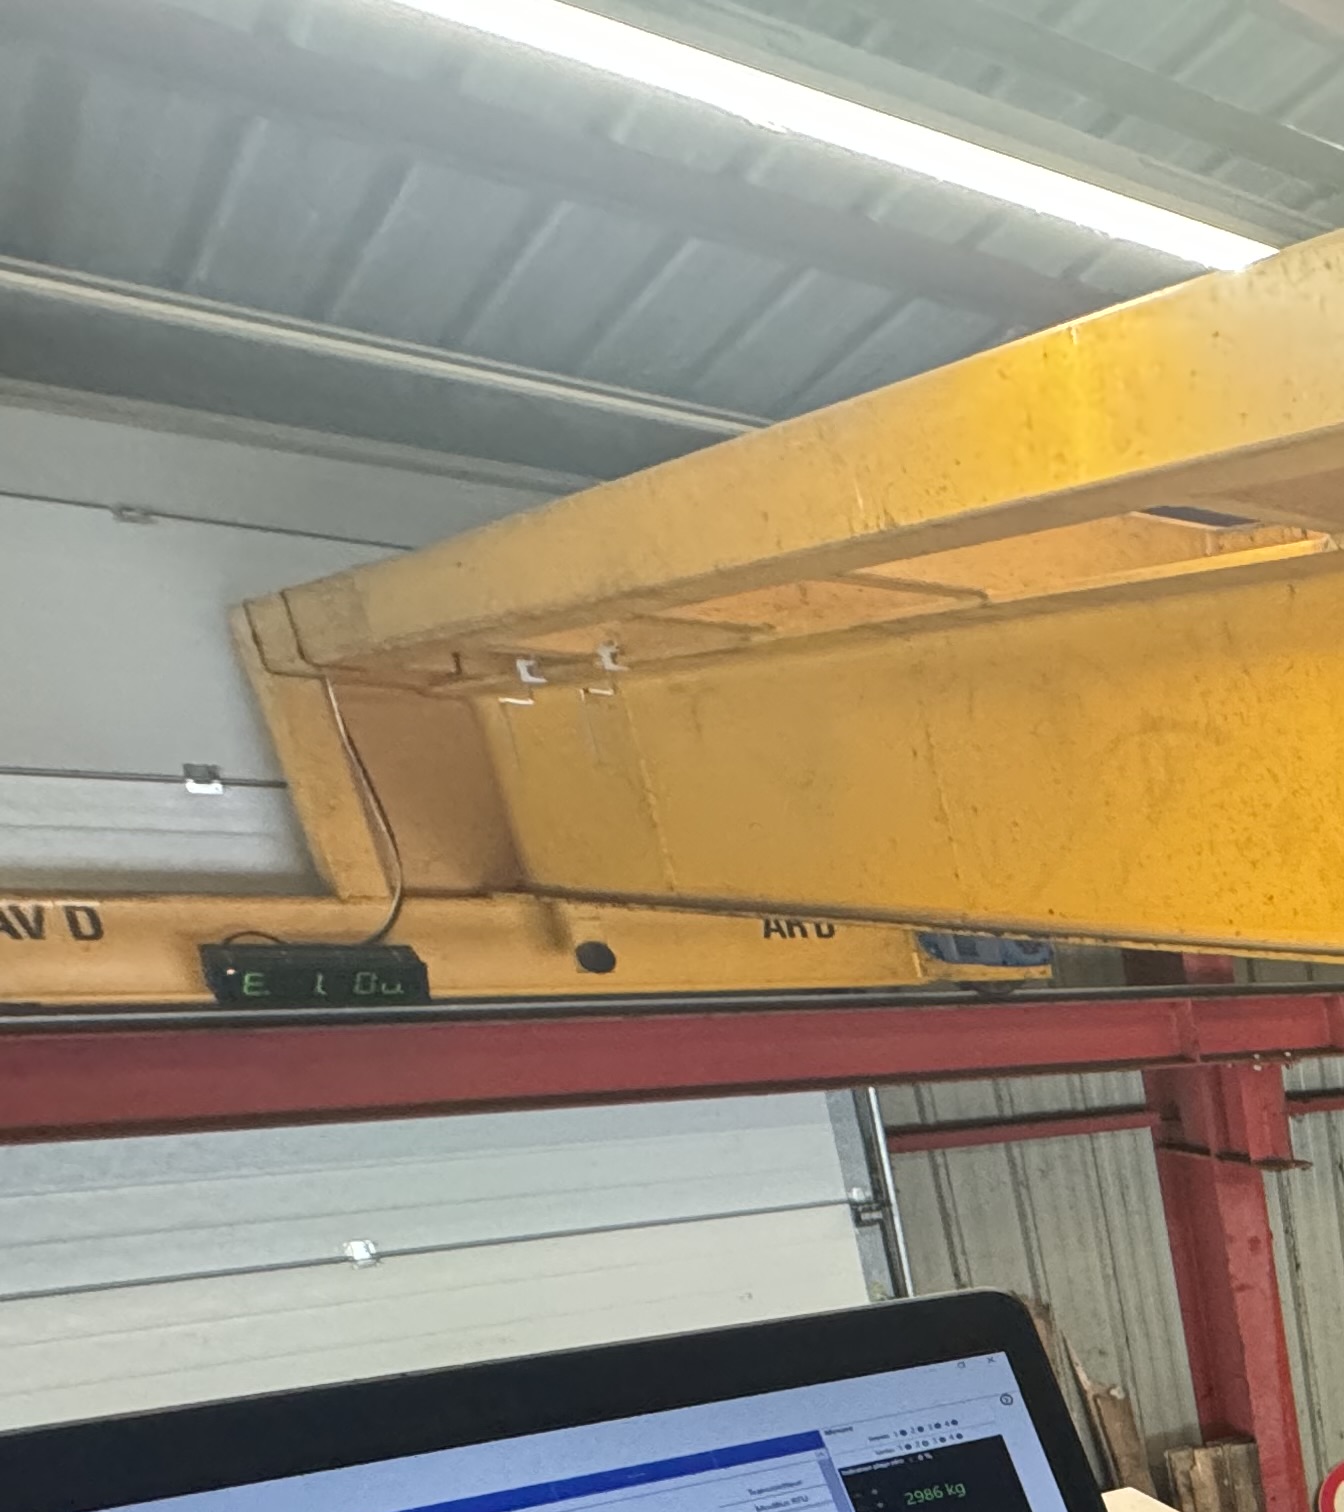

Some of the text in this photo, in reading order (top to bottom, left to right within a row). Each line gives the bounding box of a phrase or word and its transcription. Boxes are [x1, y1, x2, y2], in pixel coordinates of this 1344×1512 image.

[62, 904, 104, 941] D
[904, 1481, 967, 1505] 2986 kg
